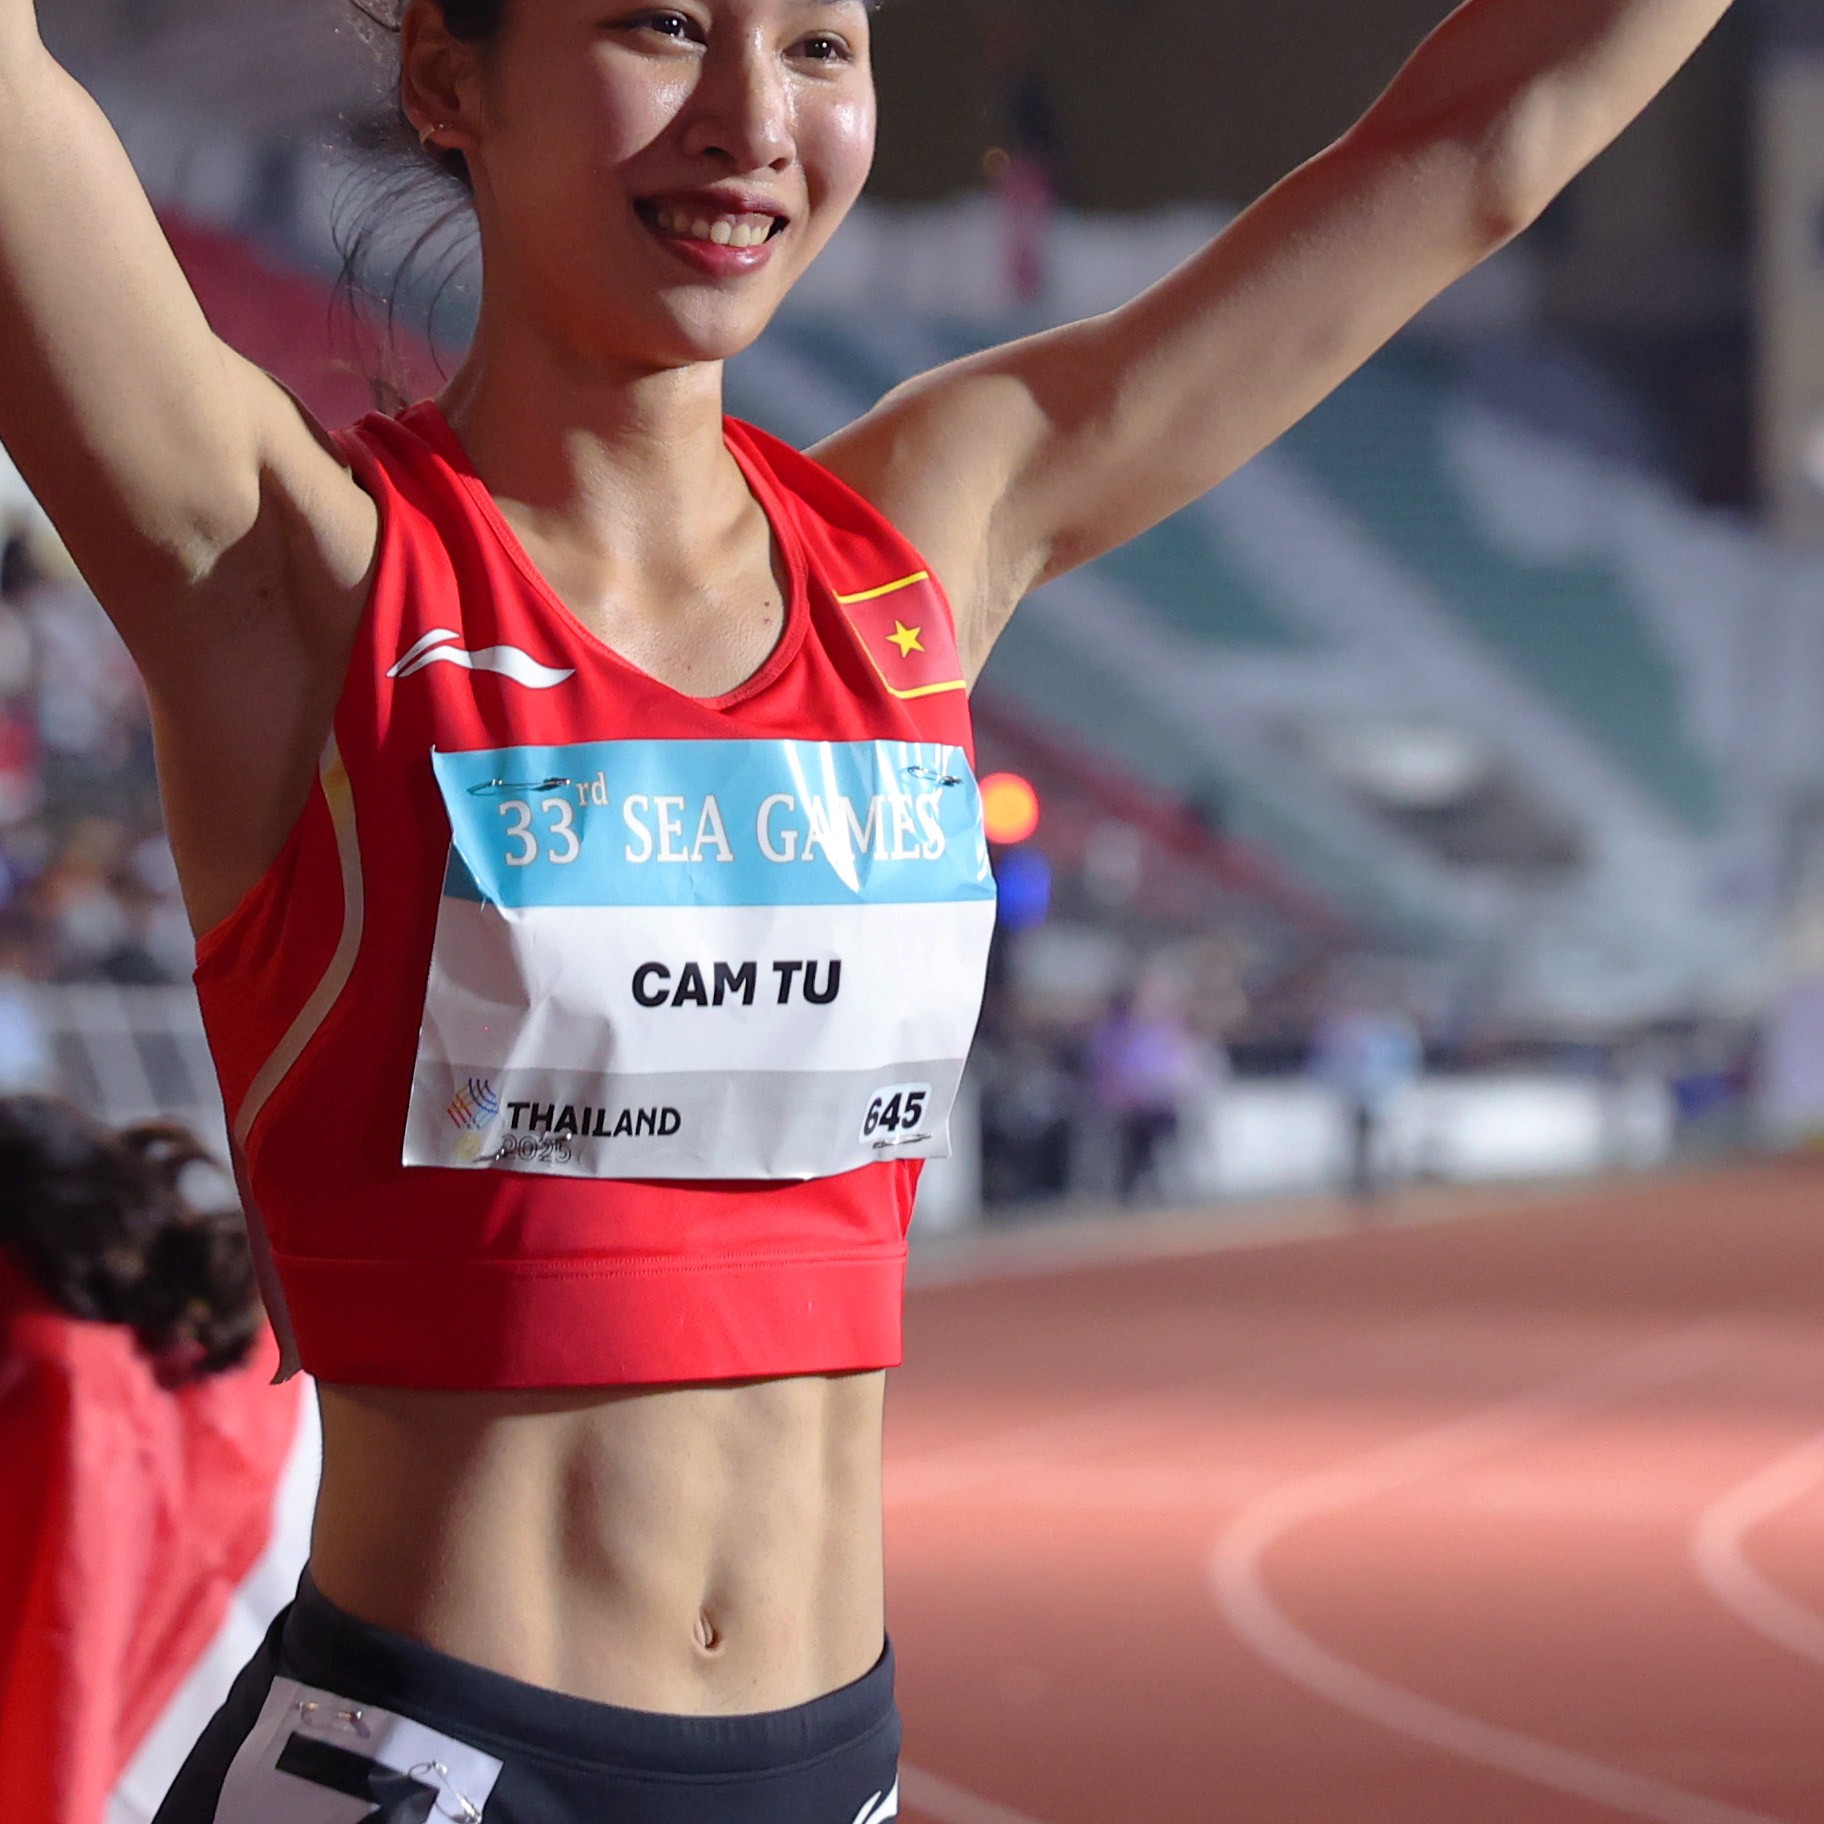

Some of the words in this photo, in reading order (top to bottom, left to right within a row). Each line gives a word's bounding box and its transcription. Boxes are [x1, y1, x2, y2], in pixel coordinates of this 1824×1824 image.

[498, 771, 609, 868] 33rd
[624, 792, 733, 865] SEA
[756, 791, 946, 866] GAMES
[630, 959, 756, 1009] CAM
[772, 959, 842, 1005] TU
[506, 1101, 682, 1138] THAILAND
[862, 1090, 926, 1136] 645
[501, 1133, 572, 1164] 2025
